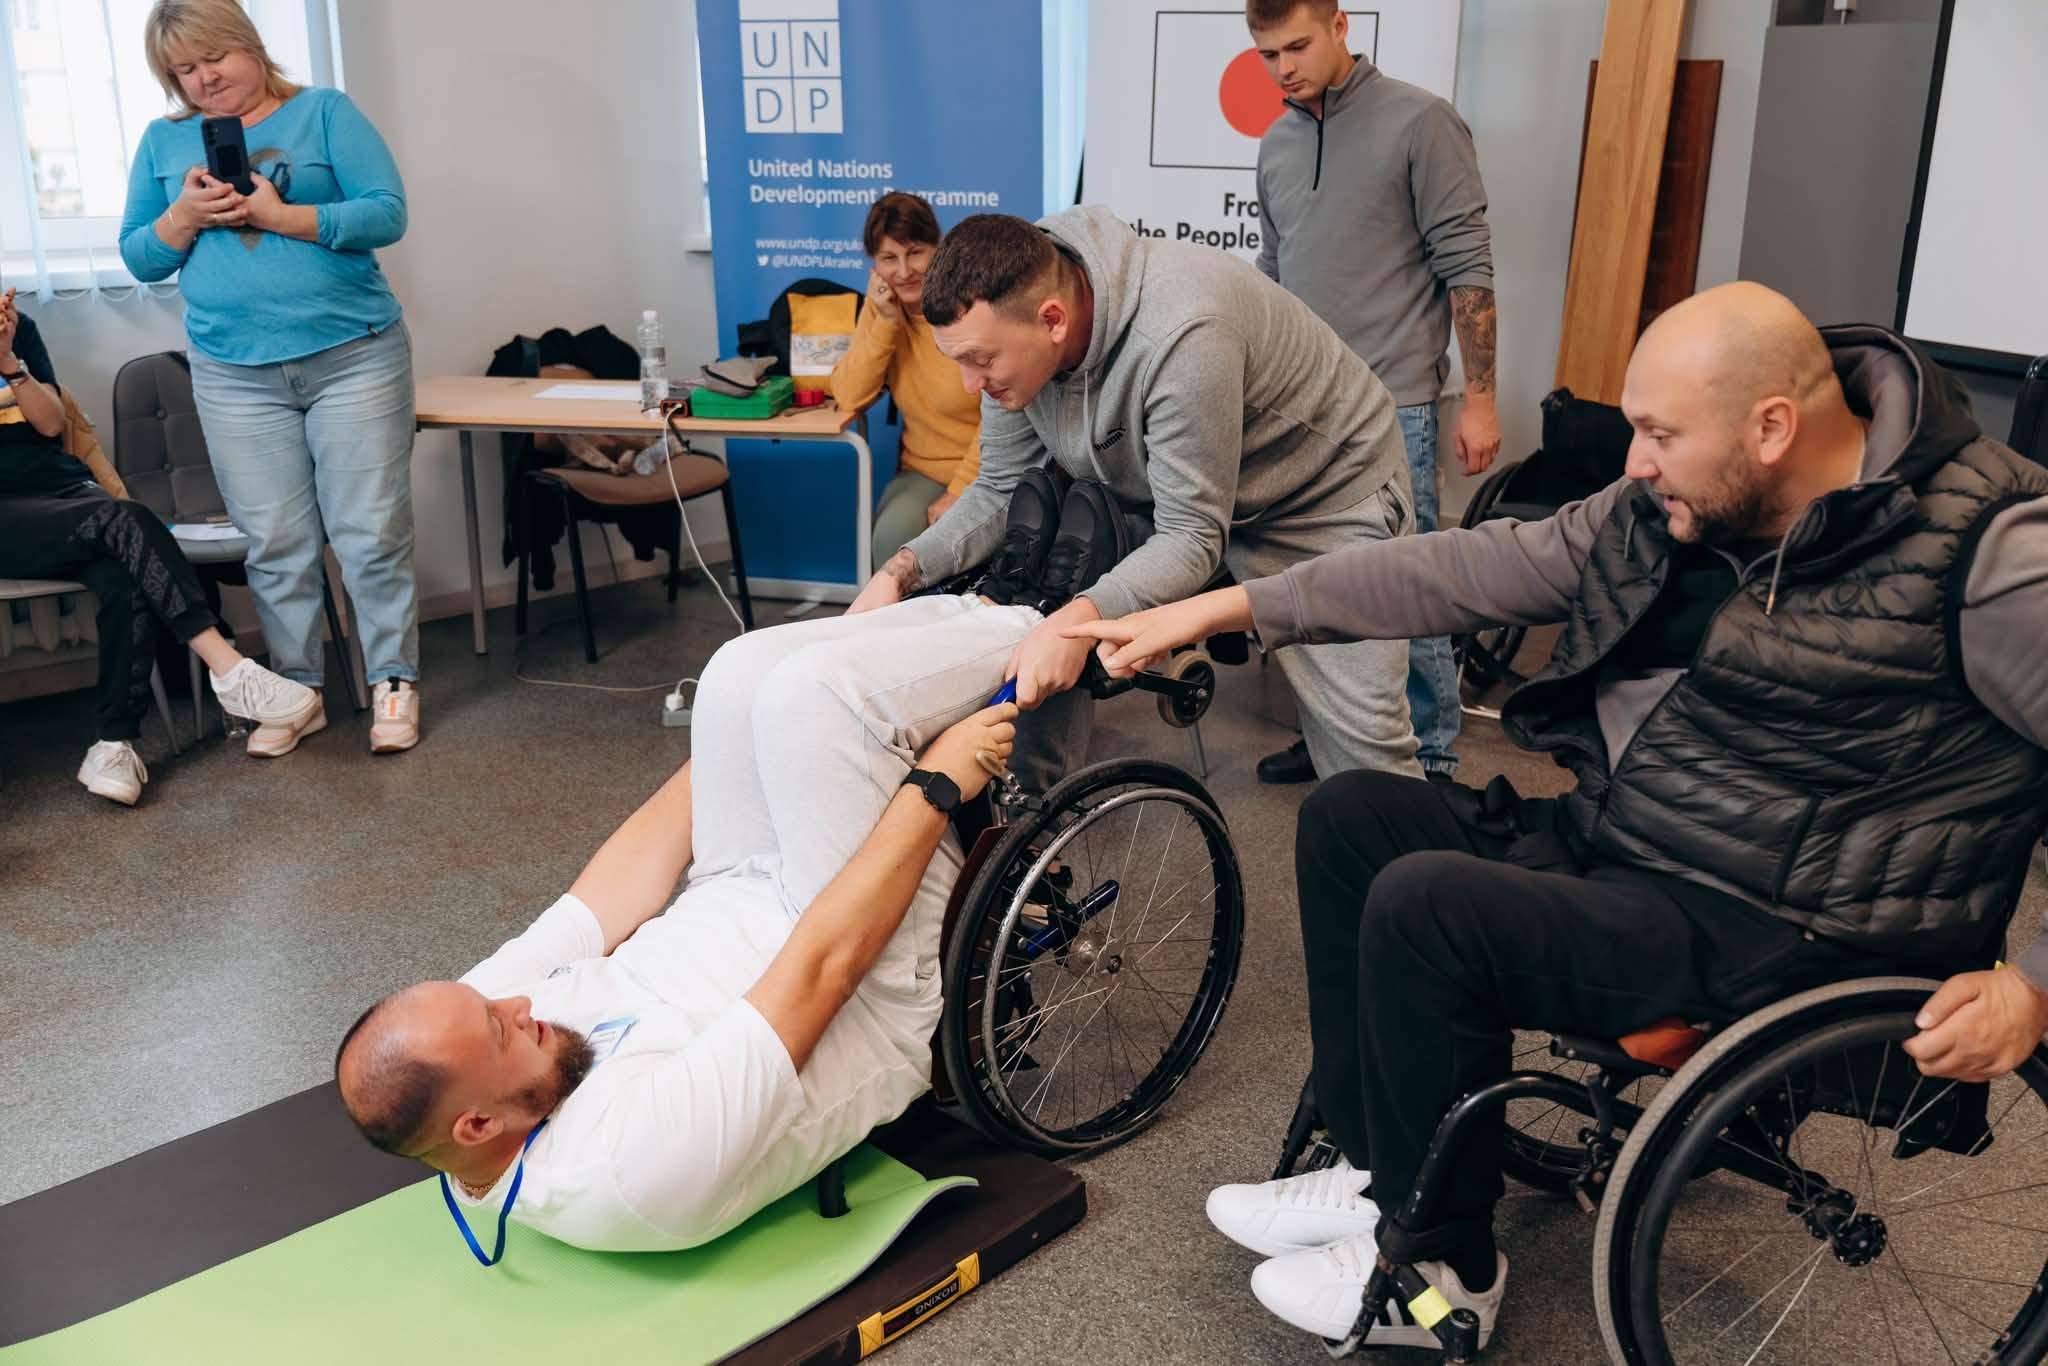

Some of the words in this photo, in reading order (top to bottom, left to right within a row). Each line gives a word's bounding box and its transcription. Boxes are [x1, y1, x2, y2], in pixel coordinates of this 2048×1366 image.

[748, 158, 814, 178] United
[817, 159, 894, 179] Nations
[750, 184, 878, 208] Development
[883, 186, 999, 207] ramme
[1223, 192, 1259, 218] Fro
[1129, 218, 1167, 239] he
[1176, 221, 1260, 251] People
[772, 254, 864, 270] @UNDPUkraine
[914, 1280, 959, 1316] BOXING
